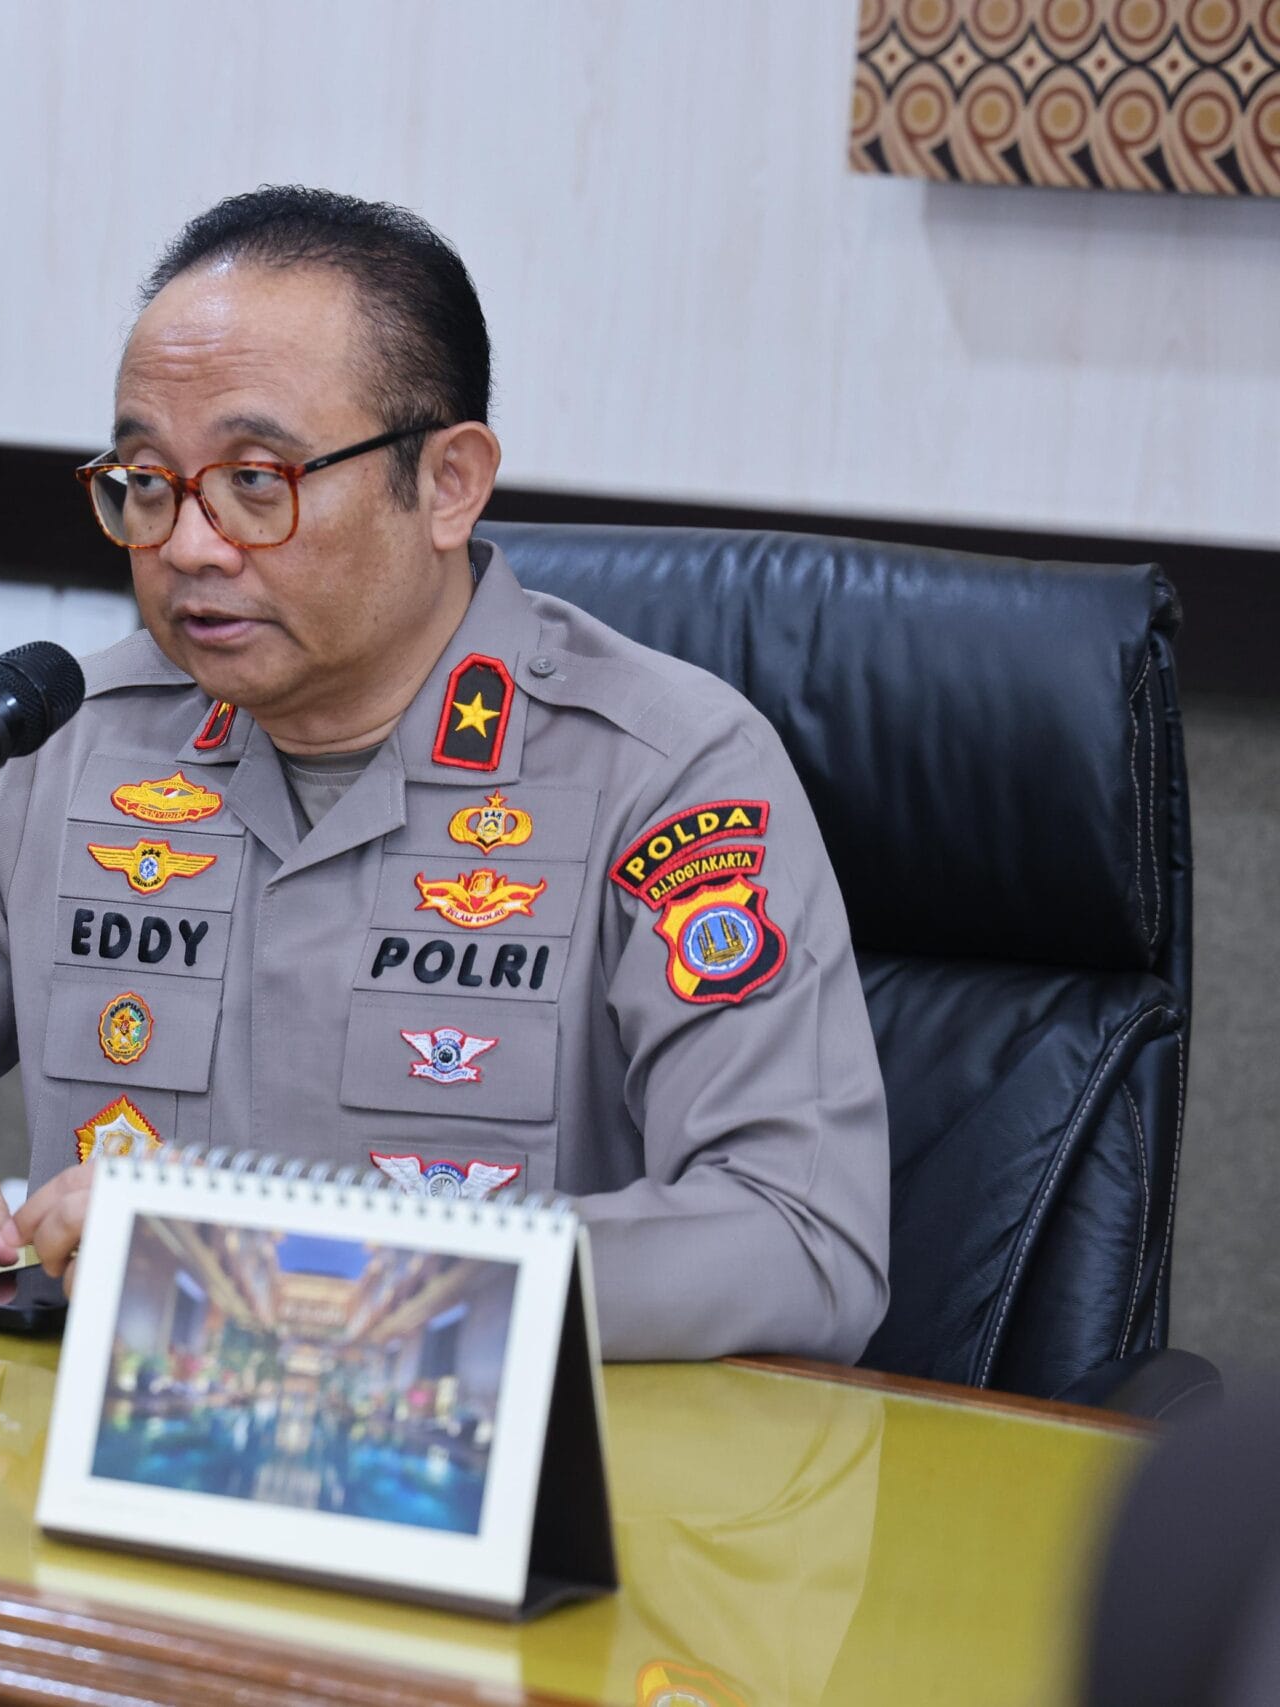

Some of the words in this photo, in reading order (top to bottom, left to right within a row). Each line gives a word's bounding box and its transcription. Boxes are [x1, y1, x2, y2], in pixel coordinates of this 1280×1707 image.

[140, 807, 186, 819] PENYIDIK
[625, 807, 752, 881] POLDA
[649, 852, 752, 900] D.I.YOGYAKARTA
[71, 908, 209, 966] EDDY
[476, 908, 505, 922] POLRI
[371, 936, 550, 990] POLRI
